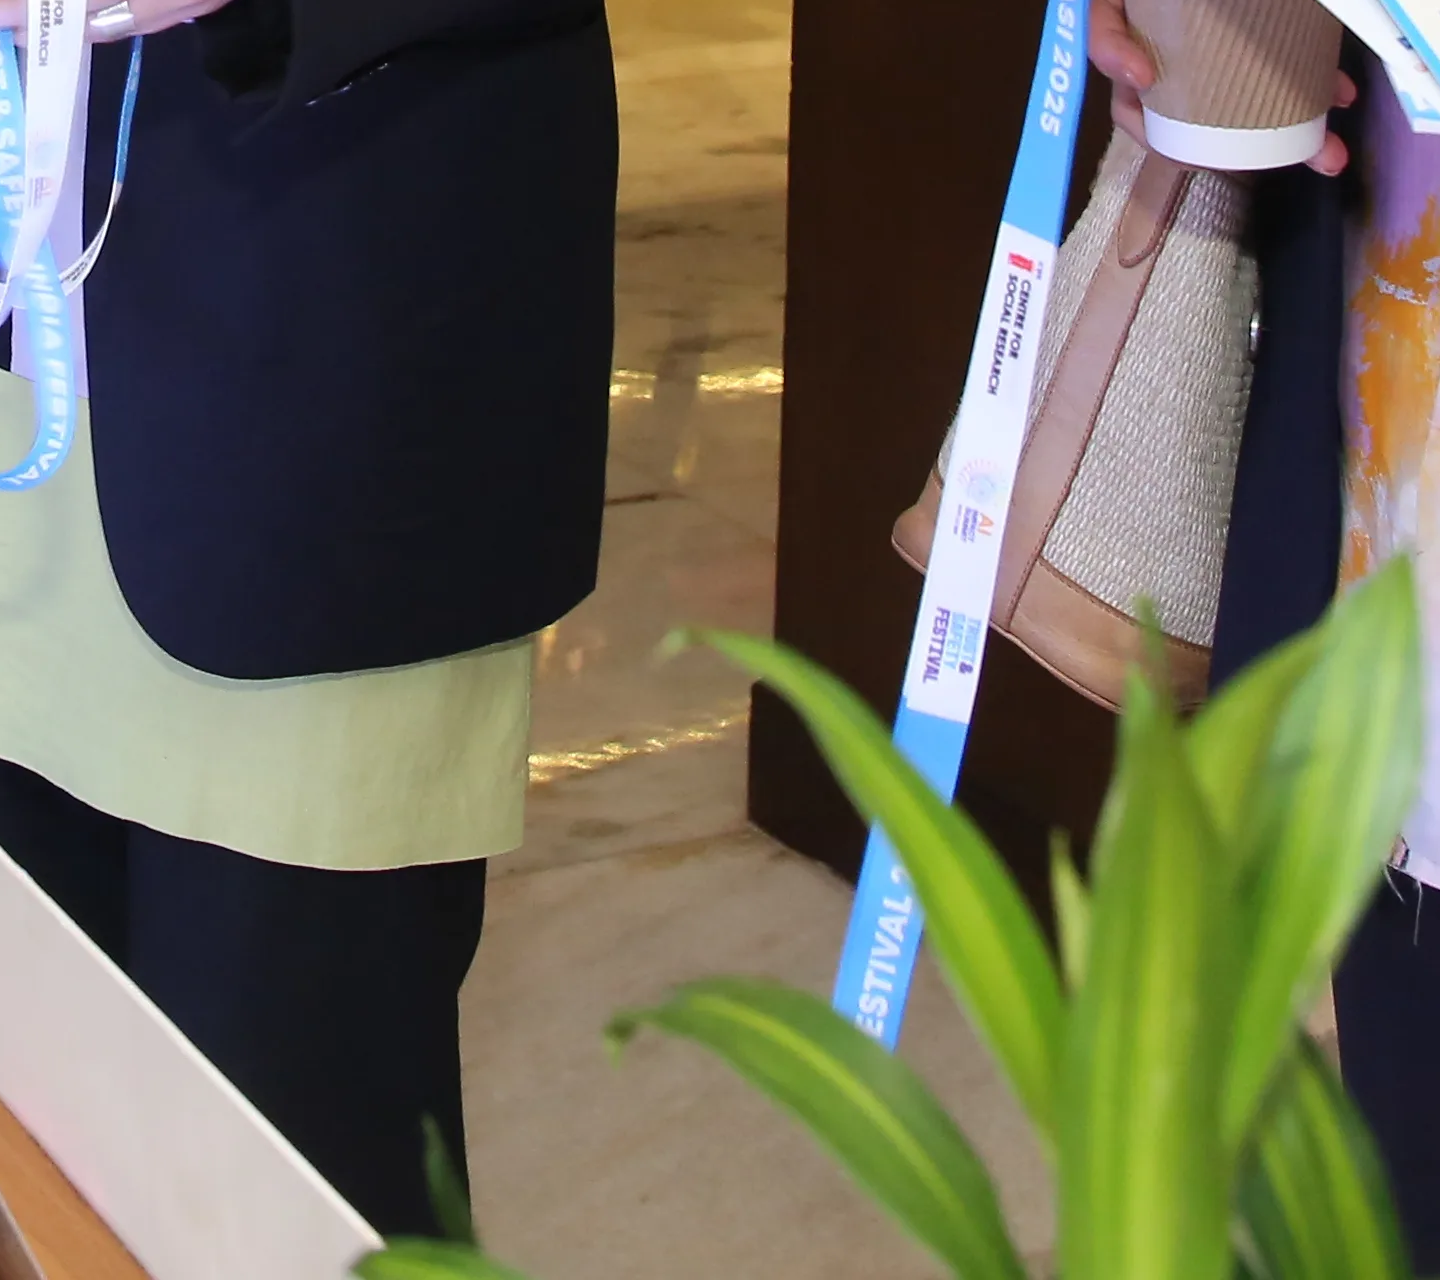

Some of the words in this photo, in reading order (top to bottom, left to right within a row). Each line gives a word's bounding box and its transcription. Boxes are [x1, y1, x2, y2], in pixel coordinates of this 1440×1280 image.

[38, 0, 51, 67] RESEARCH
[53, 0, 64, 26] FOR
[1039, 46, 1075, 136] 2025
[1000, 273, 1019, 324] SOCIAL
[1014, 279, 1032, 329] CENTRE
[987, 327, 1009, 396] RESEARCH
[1008, 331, 1023, 359] FOR
[978, 512, 995, 536] AI
[923, 606, 951, 683] FESTIVAL
[959, 662, 974, 675] &
